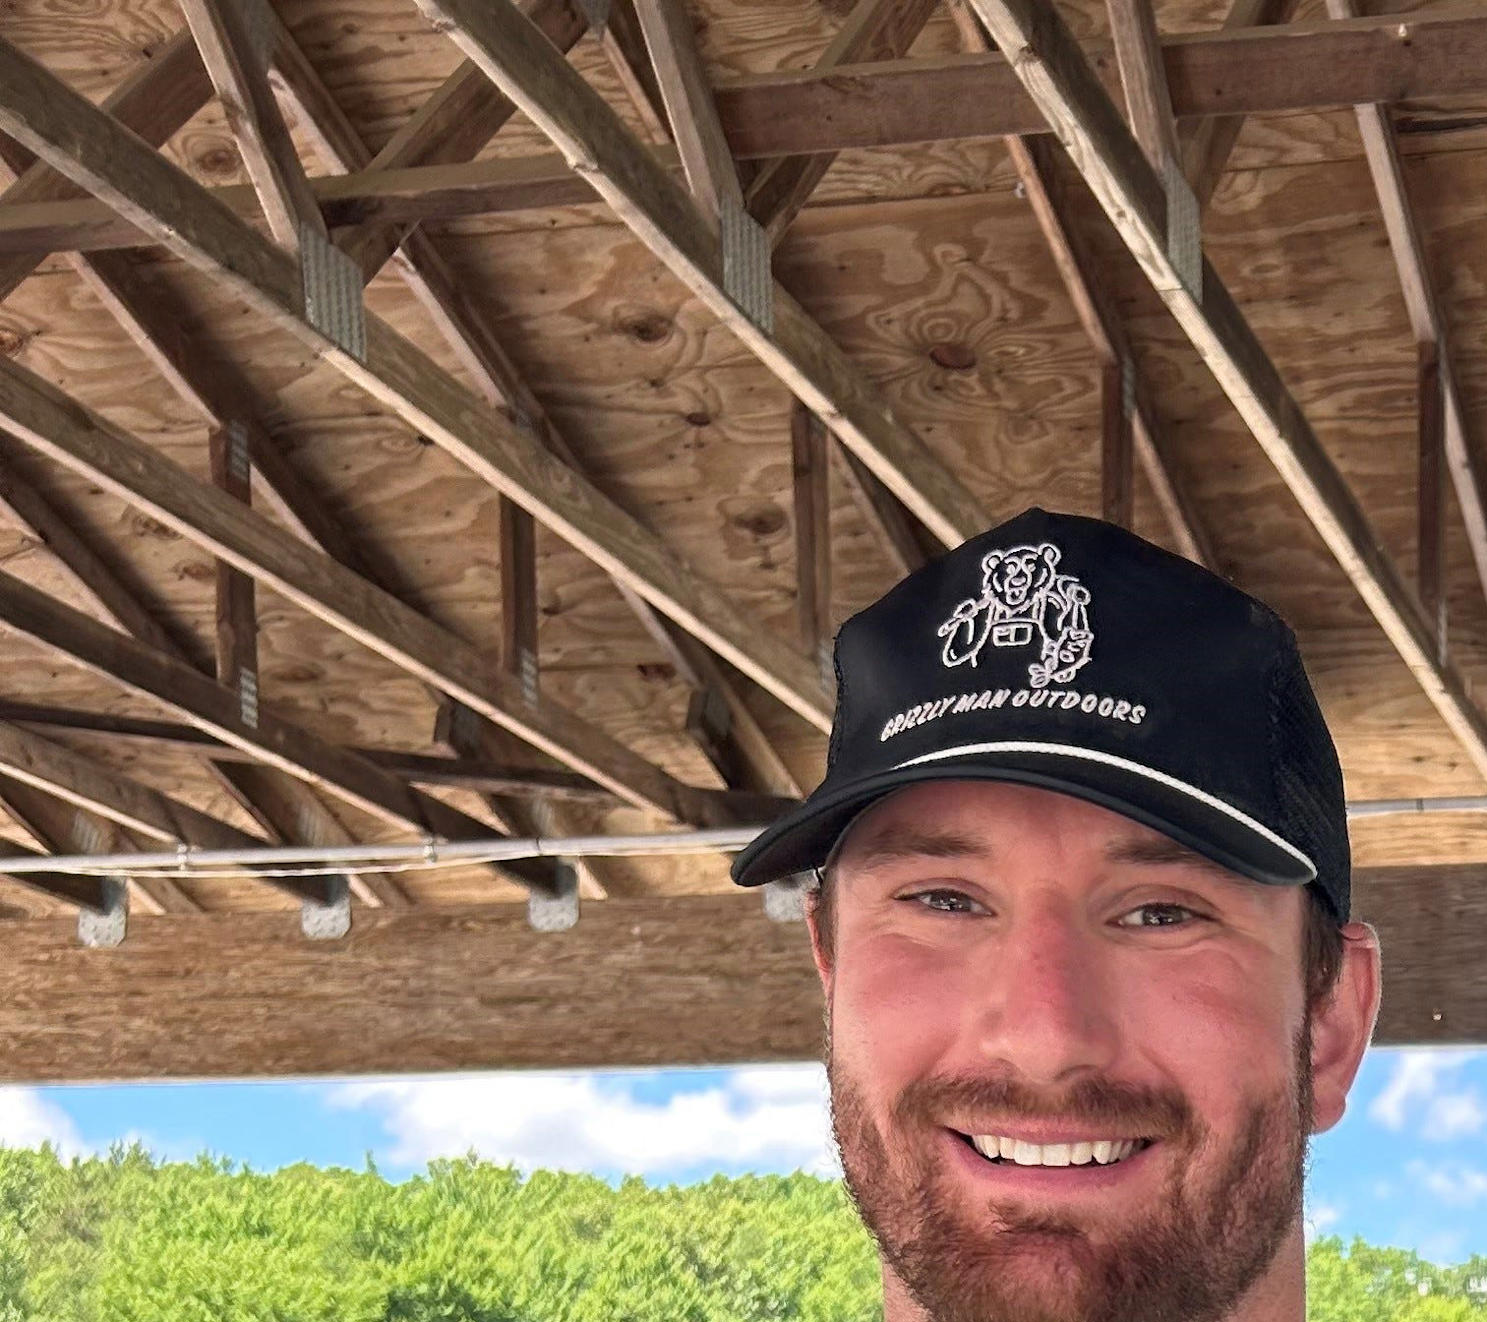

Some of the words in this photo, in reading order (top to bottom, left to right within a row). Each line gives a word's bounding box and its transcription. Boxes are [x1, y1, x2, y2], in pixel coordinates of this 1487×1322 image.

[880, 697, 957, 742] GRIZZLY
[953, 690, 1010, 715] MAN
[1011, 689, 1147, 725] OUTDOORS
